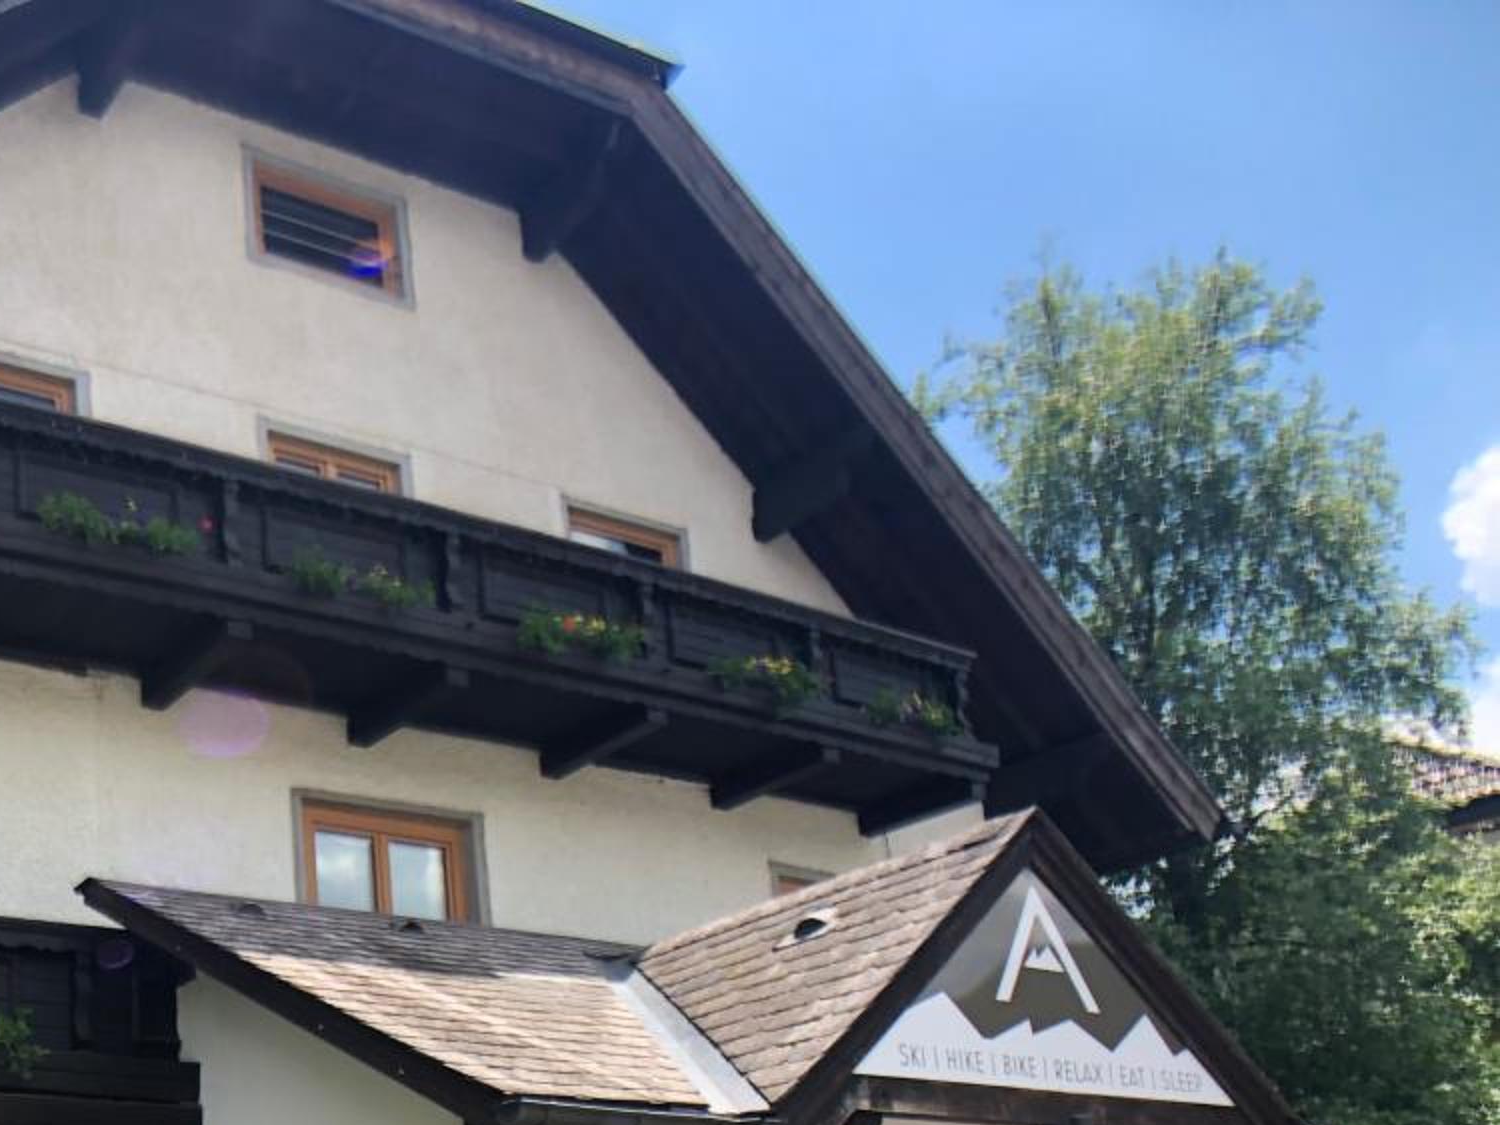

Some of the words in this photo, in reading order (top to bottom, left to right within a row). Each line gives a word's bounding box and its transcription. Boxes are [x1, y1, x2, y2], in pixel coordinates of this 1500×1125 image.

[899, 1043, 927, 1068] SKI
[946, 1048, 984, 1073] HIKE
[1003, 1055, 1037, 1079] BIKE
[1053, 1057, 1104, 1085] RELAX
[1119, 1064, 1145, 1089] EAT
[1159, 1069, 1203, 1092] SLEEP
